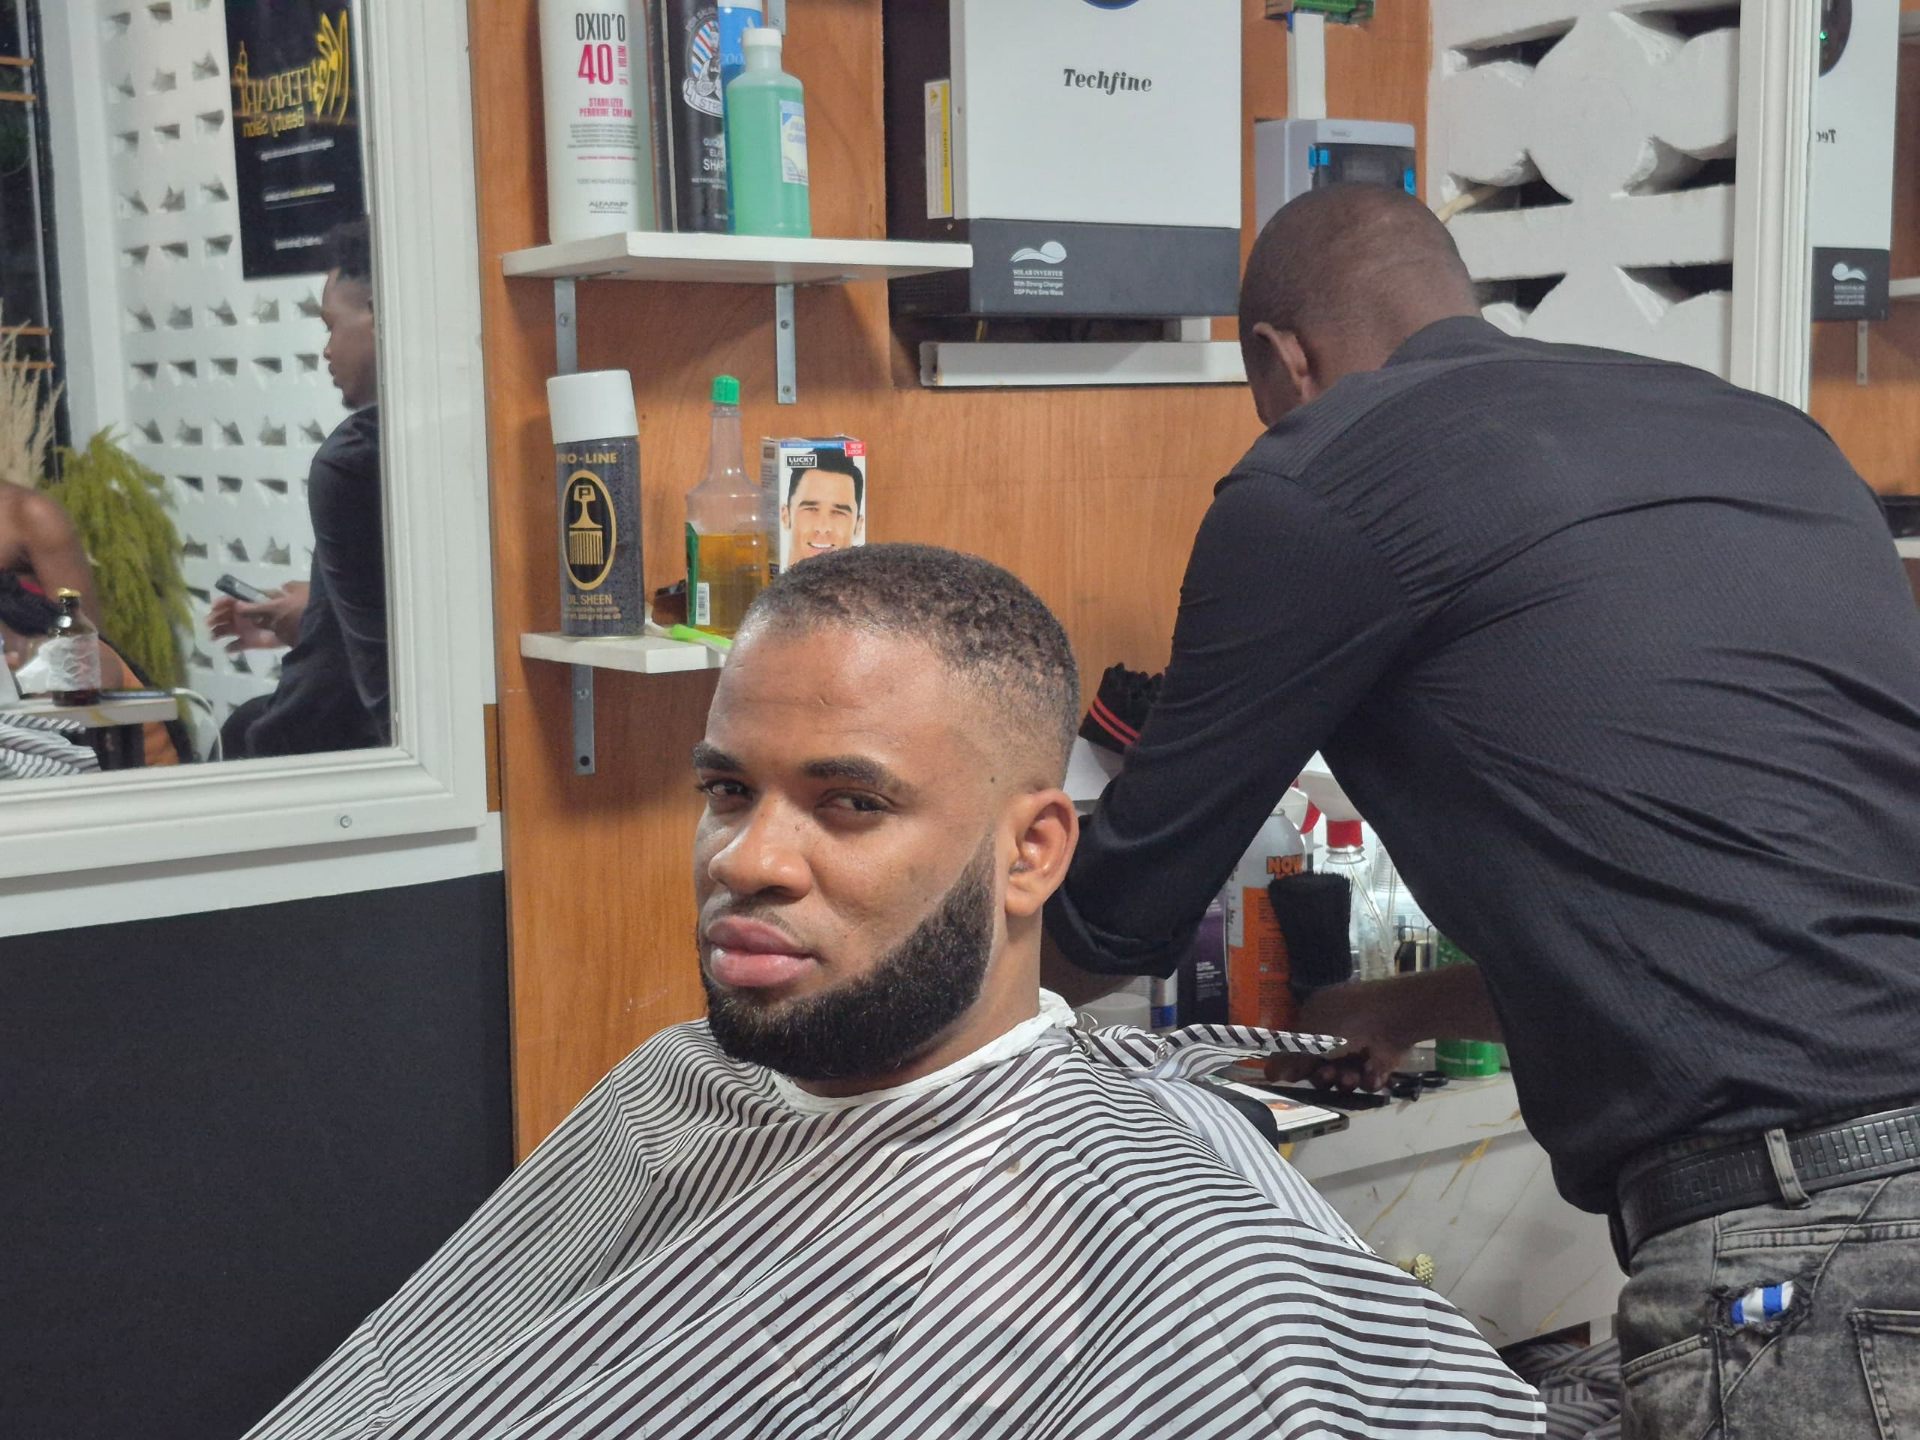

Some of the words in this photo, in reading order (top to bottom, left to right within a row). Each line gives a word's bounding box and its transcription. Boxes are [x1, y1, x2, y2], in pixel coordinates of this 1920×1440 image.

[575, 13, 626, 42] OXID'O
[577, 43, 614, 85] 40
[1063, 68, 1153, 96] Techfine
[580, 593, 613, 605] SHEEN
